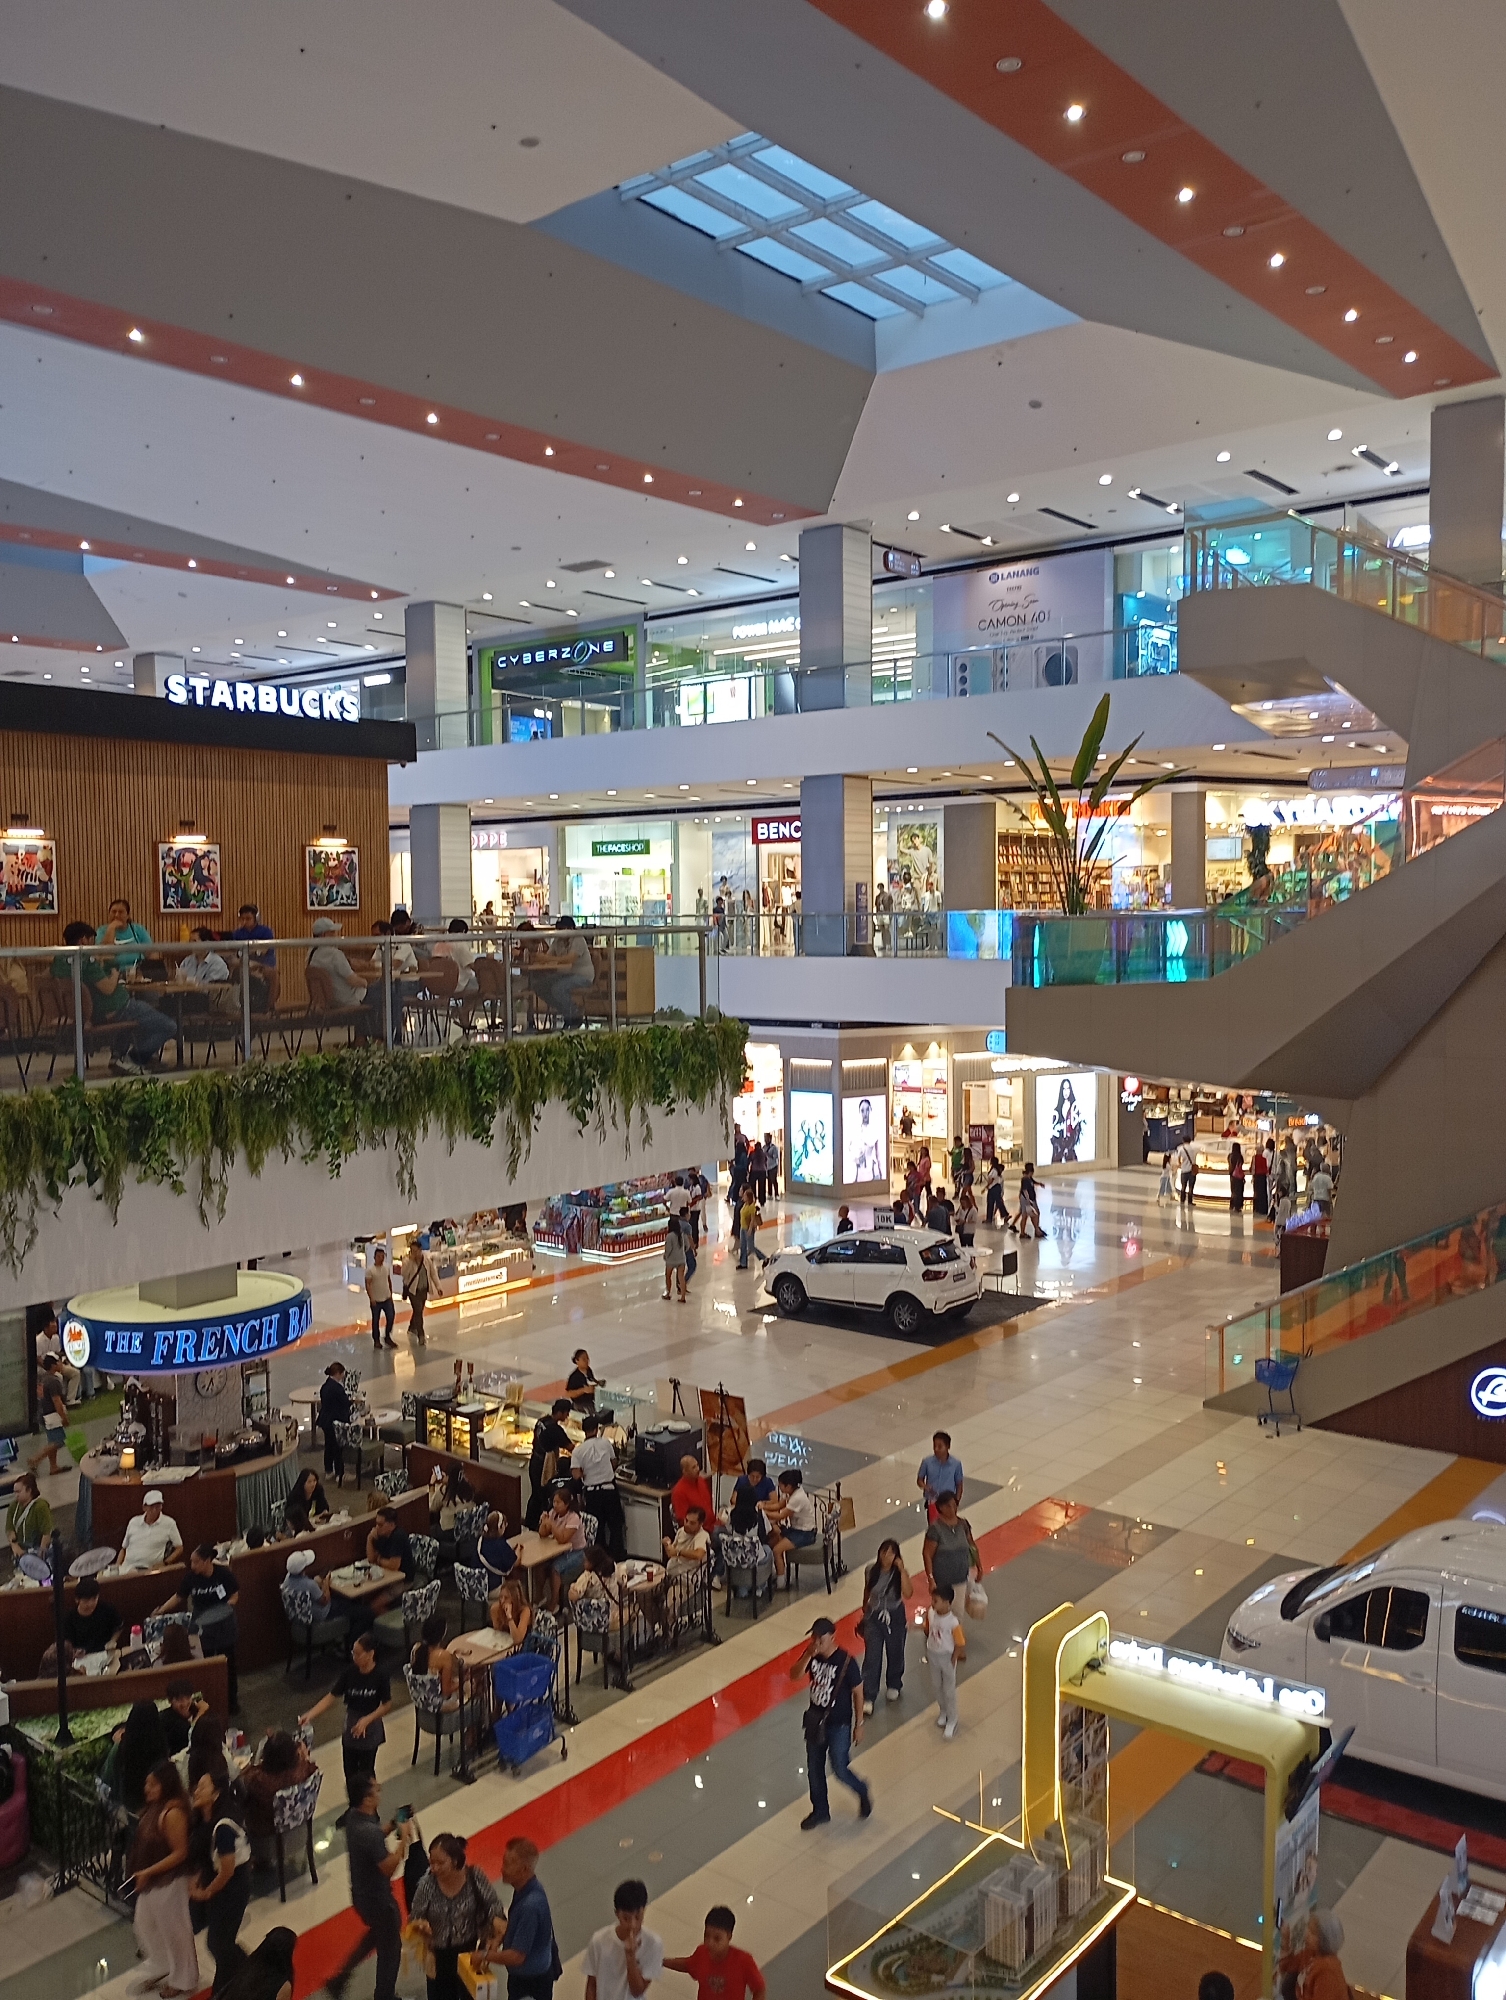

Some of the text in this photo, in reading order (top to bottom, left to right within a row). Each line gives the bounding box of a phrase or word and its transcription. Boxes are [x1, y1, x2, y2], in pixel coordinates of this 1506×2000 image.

[1000, 566, 1040, 581] LANANG
[977, 610, 1046, 632] CAMON 40
[497, 639, 615, 670] CYBERZONE
[165, 674, 360, 723] STARBUCKS
[104, 1330, 144, 1354] THE
[151, 1313, 281, 1366] FRENCH
